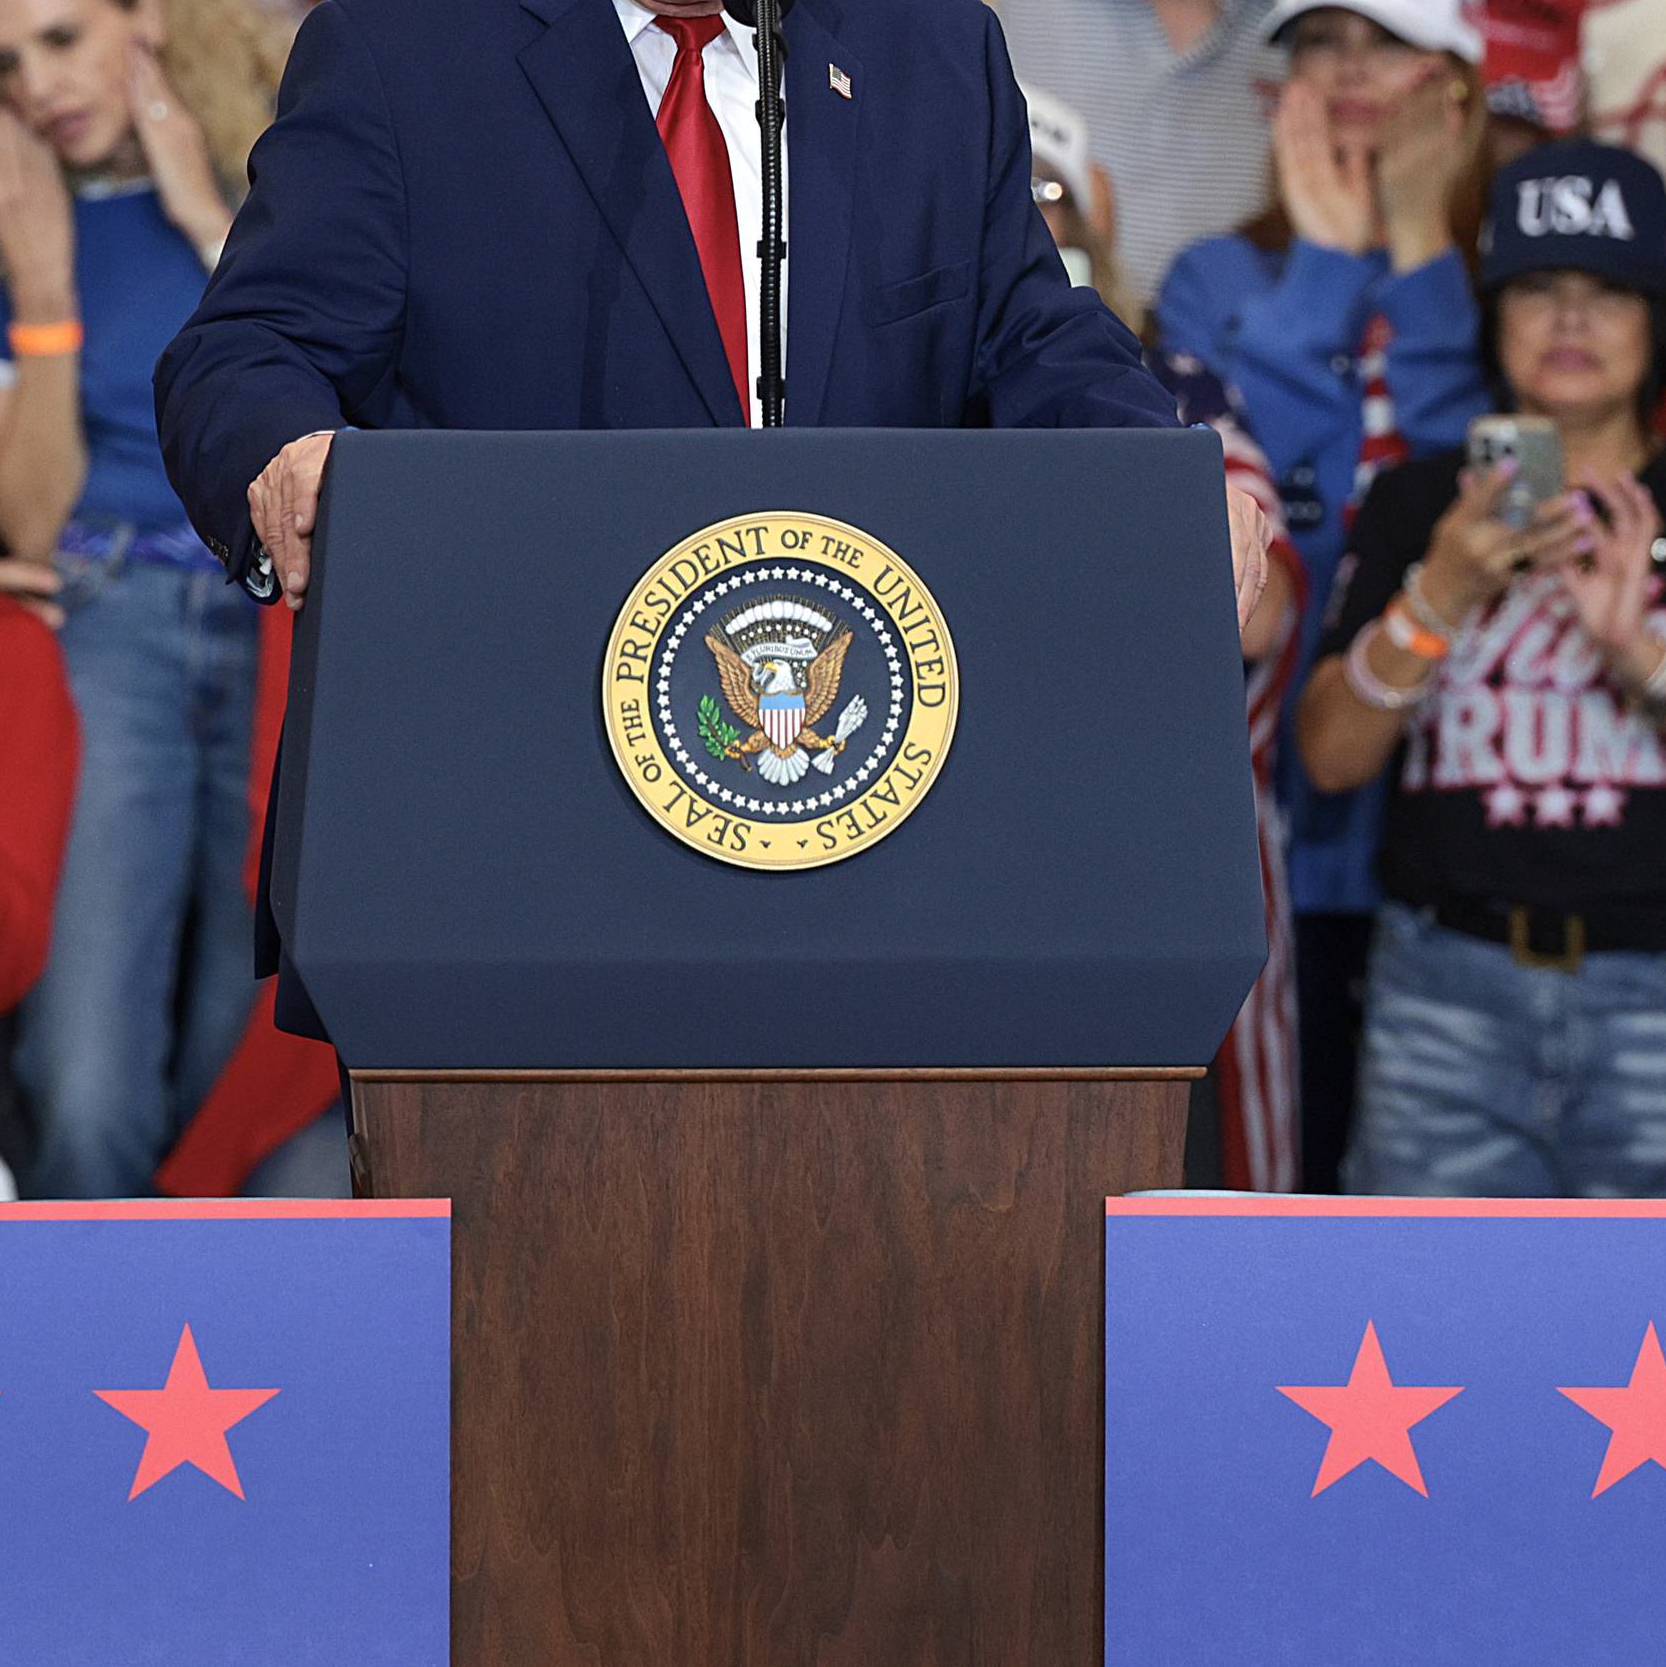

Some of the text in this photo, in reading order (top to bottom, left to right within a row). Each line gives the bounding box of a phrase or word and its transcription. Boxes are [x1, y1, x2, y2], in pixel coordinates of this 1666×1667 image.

[1517, 176, 1633, 241] USA
[616, 527, 946, 851] SEAL OF THE PRESIDENT OF THE UNITED STATES
